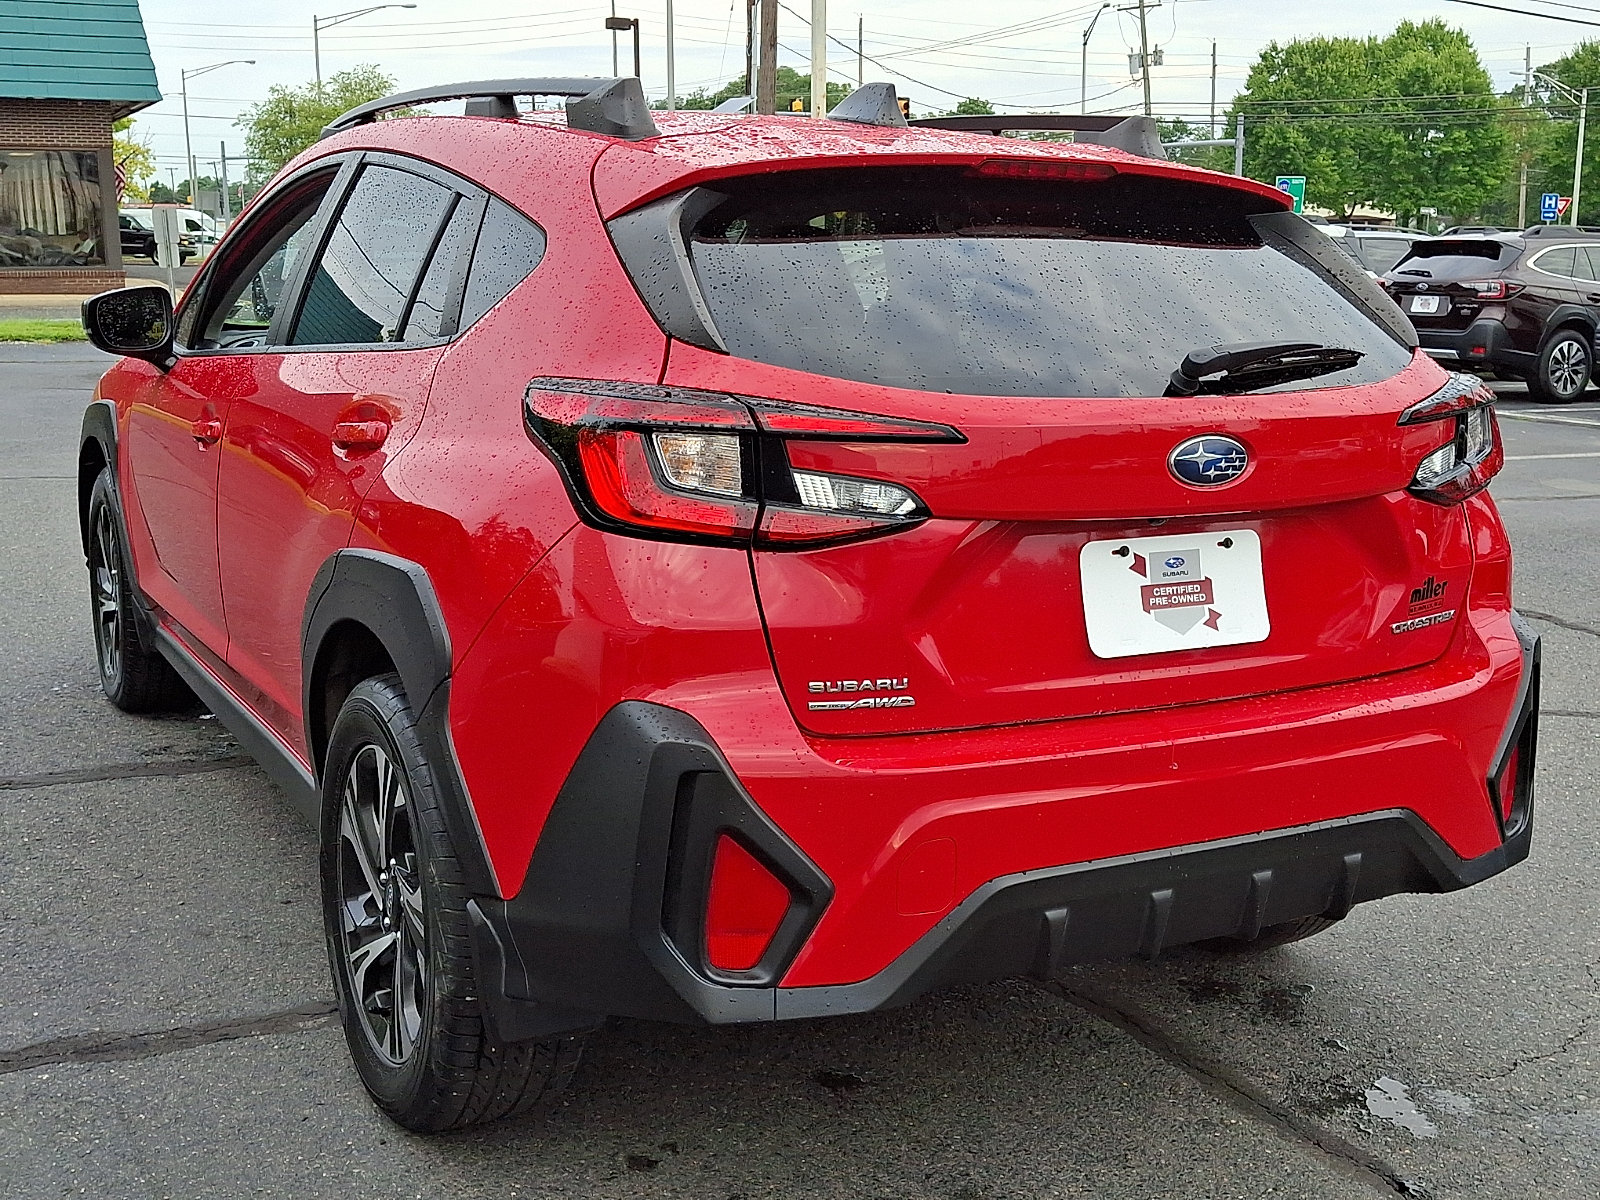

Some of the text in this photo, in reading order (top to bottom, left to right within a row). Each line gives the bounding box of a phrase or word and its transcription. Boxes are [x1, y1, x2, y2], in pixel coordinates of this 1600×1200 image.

[1544, 195, 1556, 209] H
[1162, 570, 1189, 578] SUBARU
[1153, 584, 1201, 597] CERTIFIED
[1409, 576, 1448, 603] miller
[1149, 593, 1207, 607] PRE-OWNED
[808, 678, 909, 693] SUBARU
[849, 696, 916, 709] AWD
